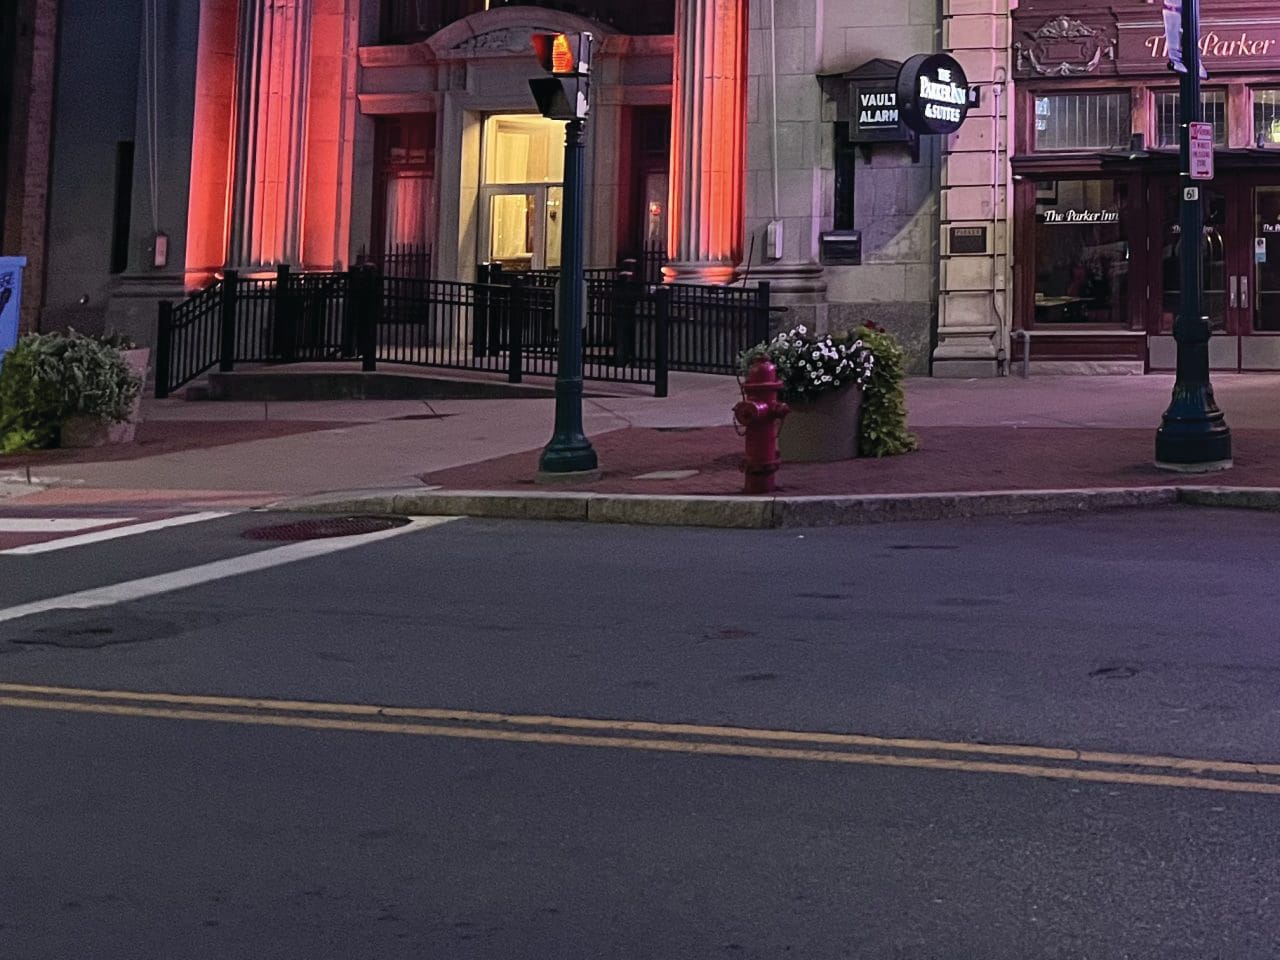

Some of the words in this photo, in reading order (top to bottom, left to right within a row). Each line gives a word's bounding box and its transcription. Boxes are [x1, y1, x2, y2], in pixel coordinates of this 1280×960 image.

[1198, 31, 1275, 56] Parker
[860, 93, 896, 106] VAULT
[859, 110, 899, 122] ALARM
[1044, 209, 1064, 221] The
[1066, 209, 1100, 221] Parker
[1101, 209, 1119, 221] Inn
